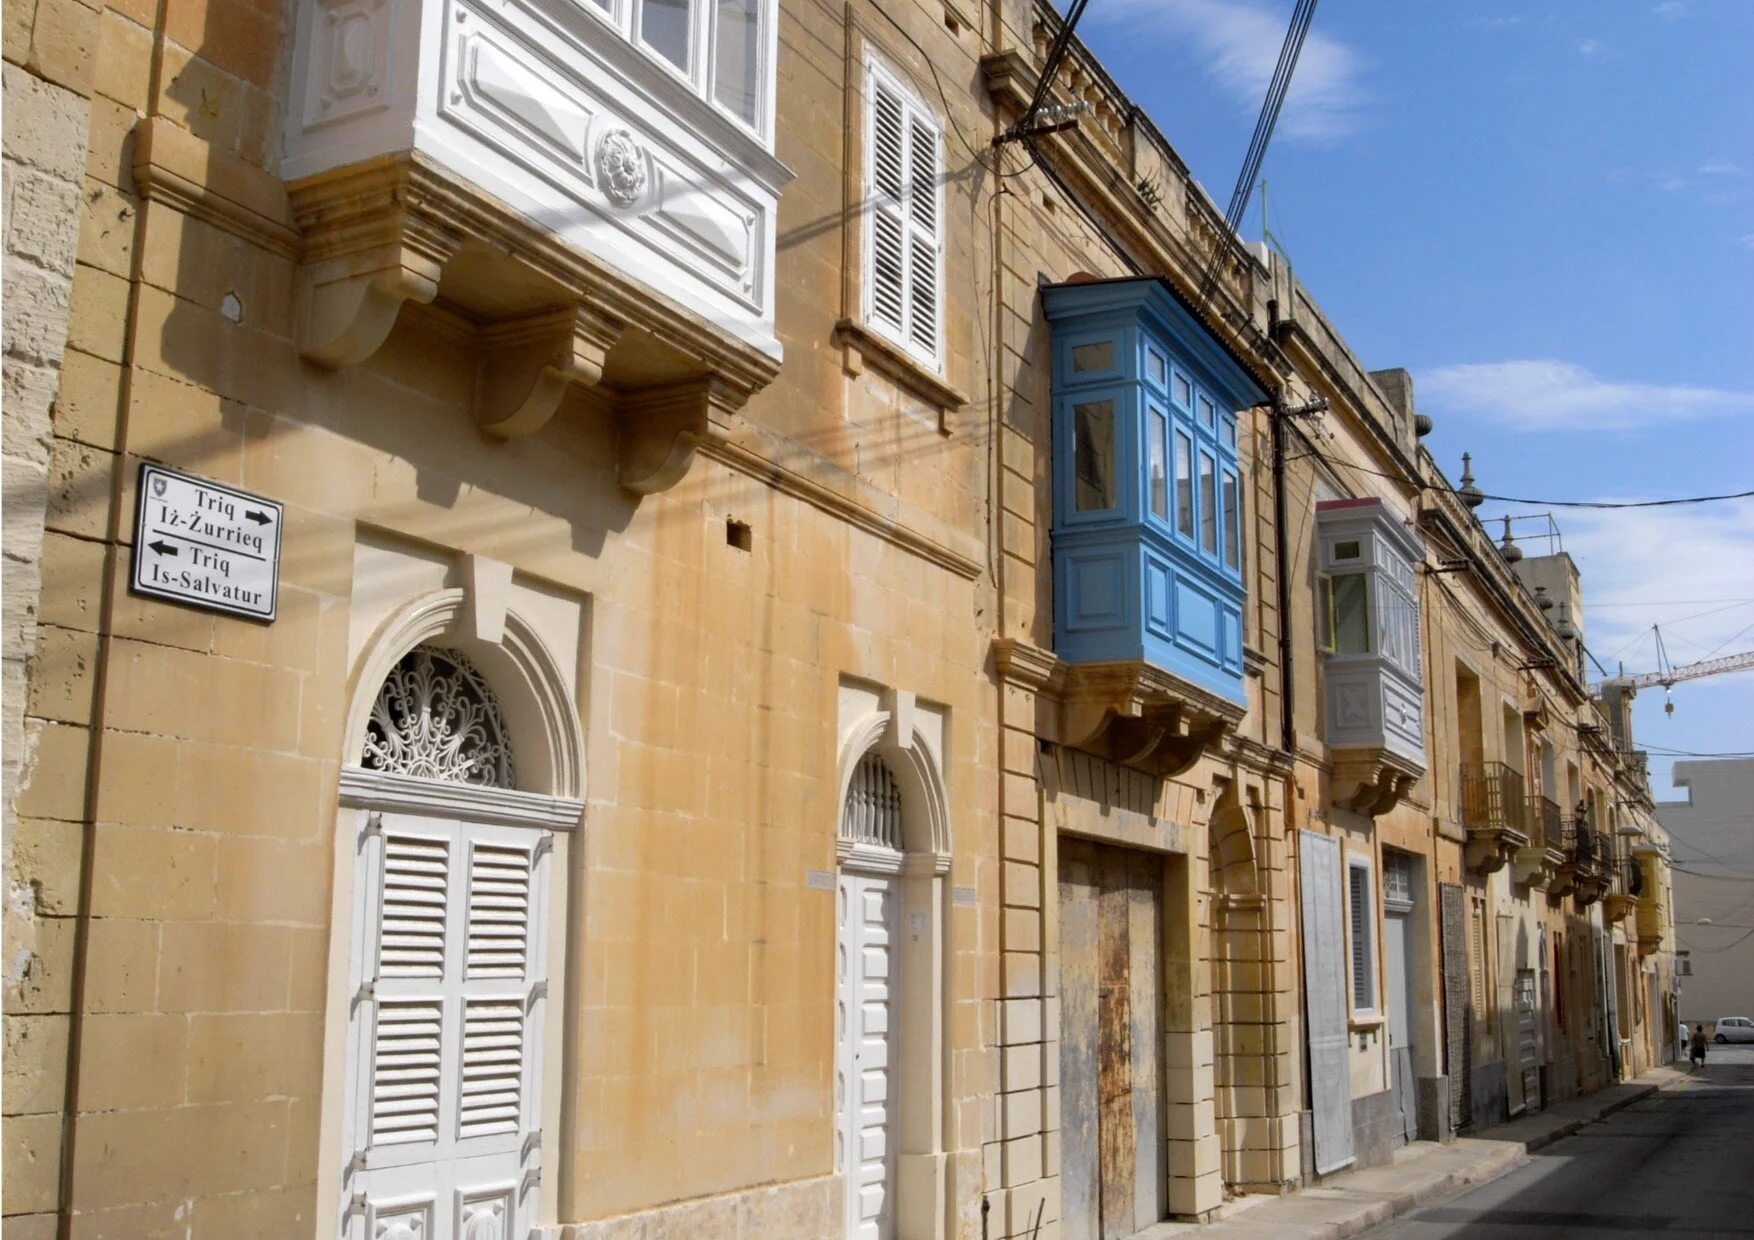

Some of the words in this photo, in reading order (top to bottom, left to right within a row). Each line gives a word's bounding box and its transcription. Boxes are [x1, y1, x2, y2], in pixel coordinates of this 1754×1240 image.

[195, 489, 235, 521] Triq
[160, 505, 263, 554] Iż-Żurrieq
[190, 546, 230, 577] Triq
[152, 564, 262, 605] Is-Salvatur
